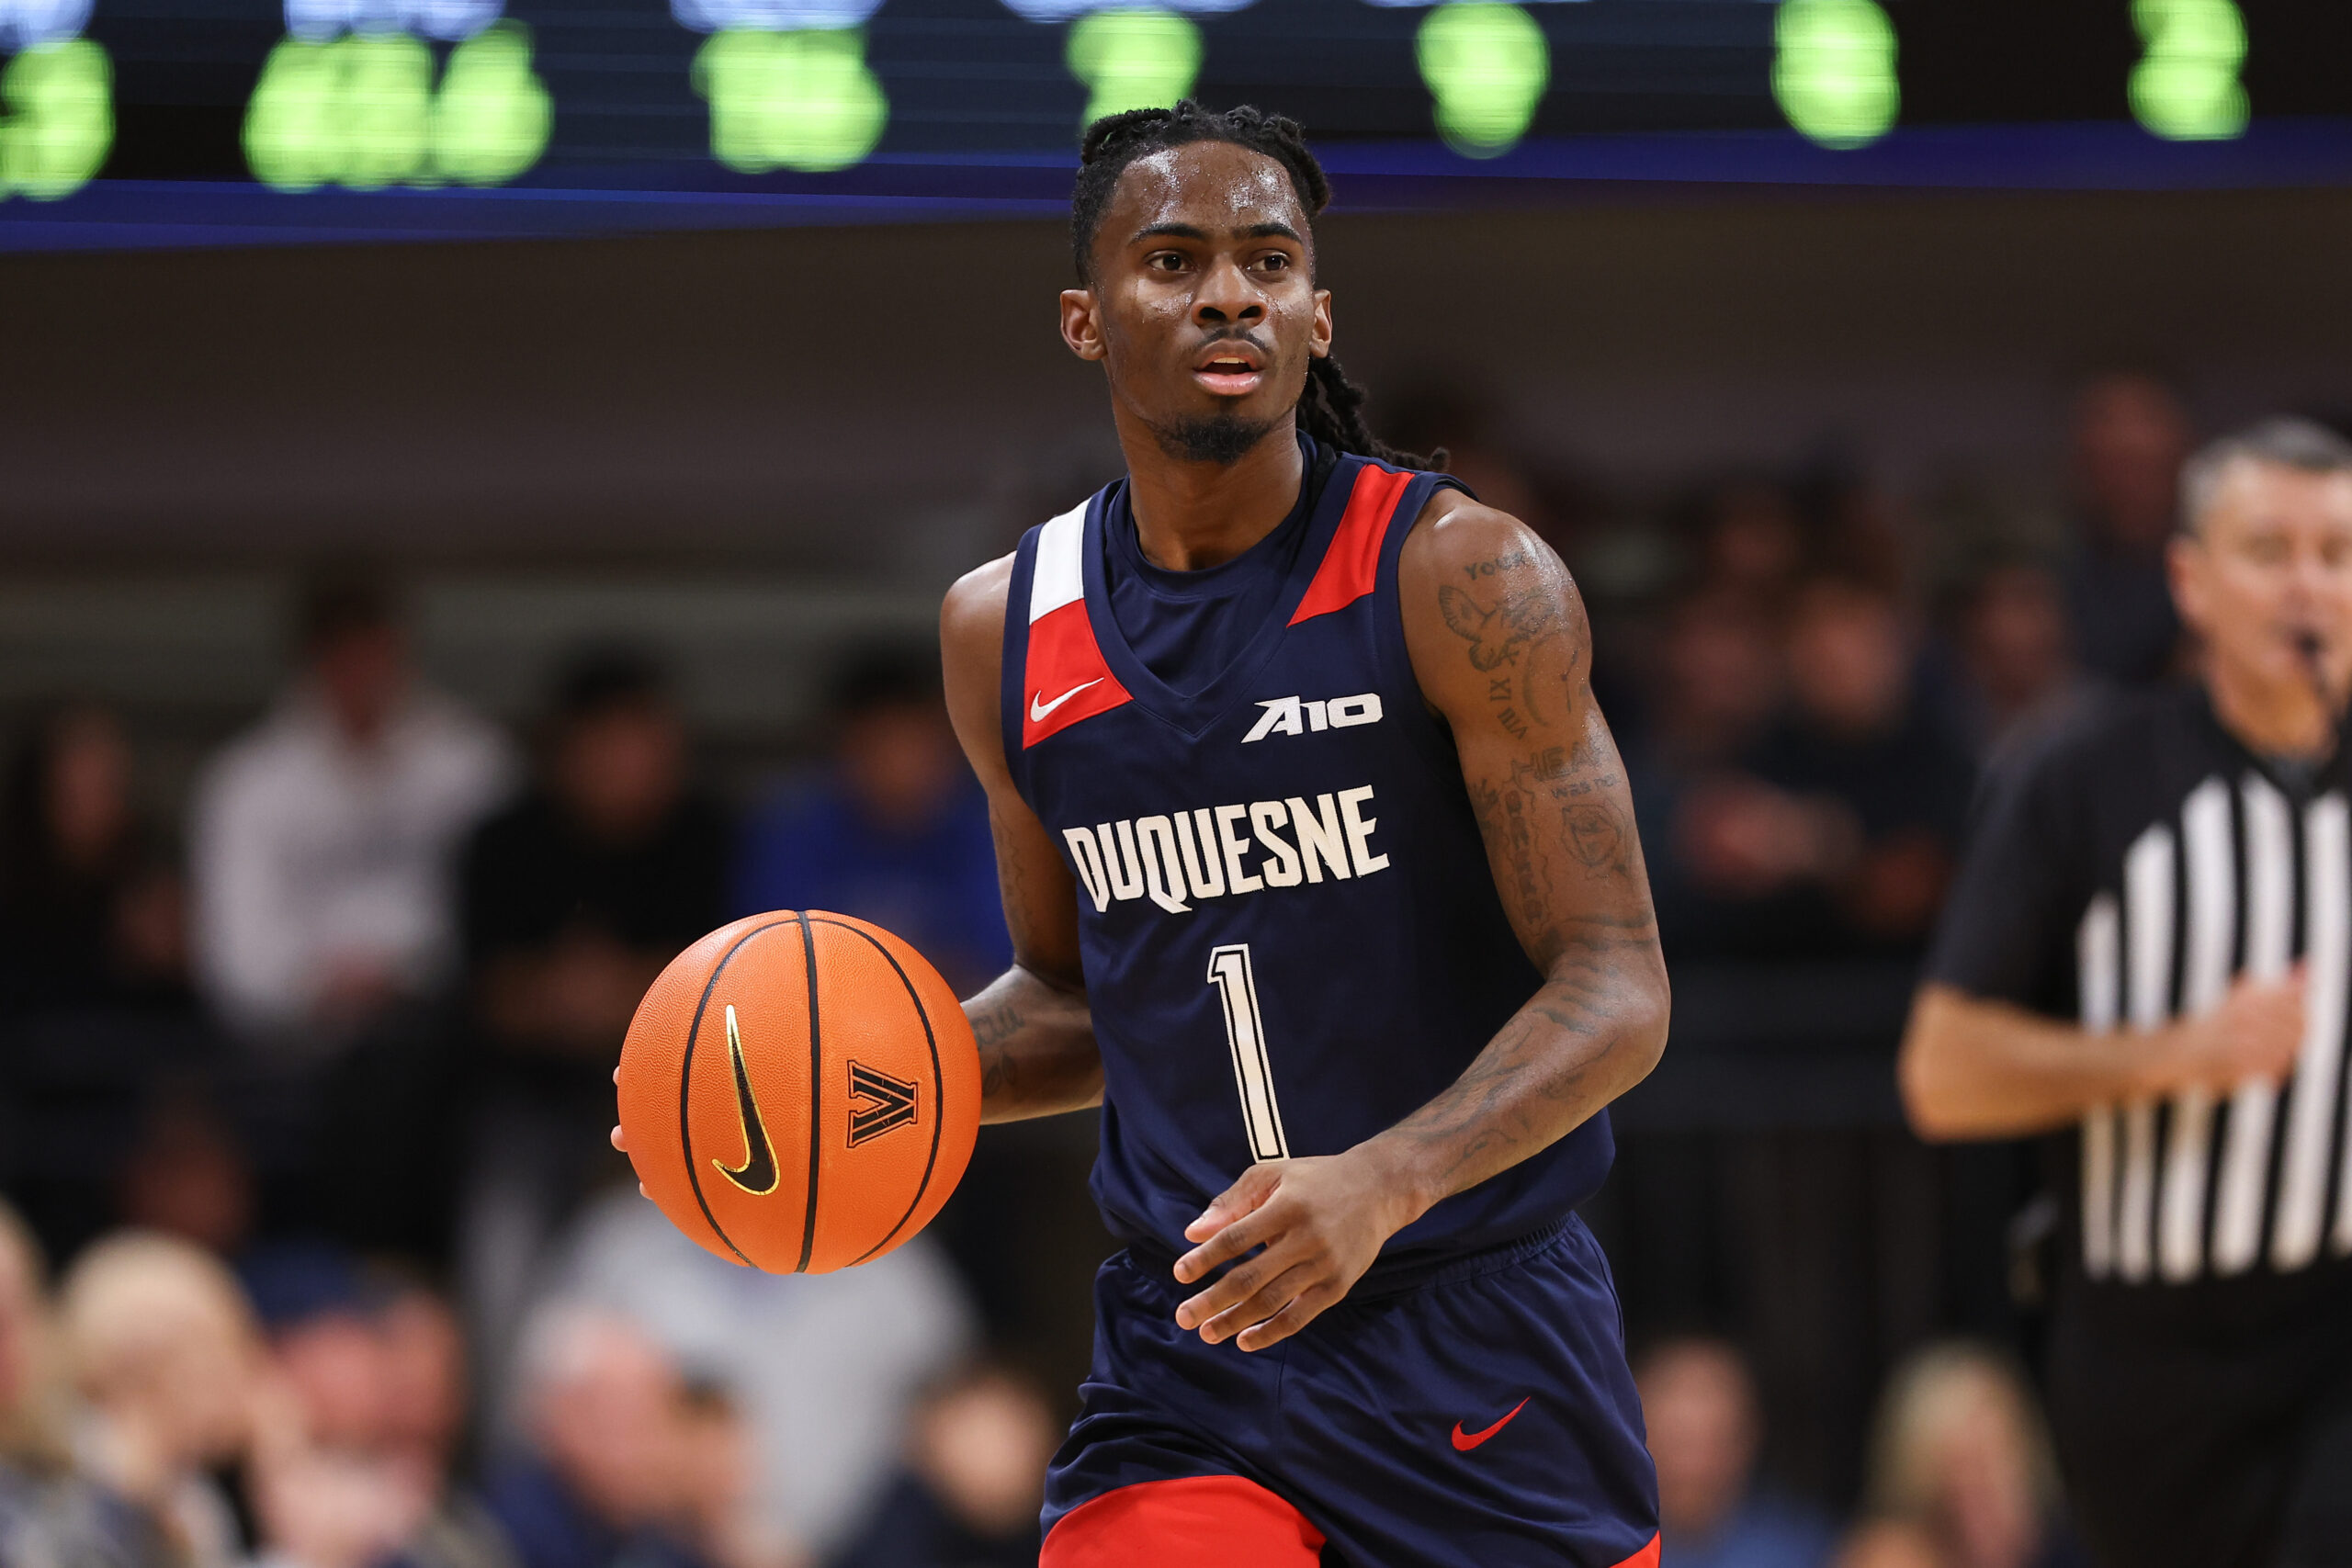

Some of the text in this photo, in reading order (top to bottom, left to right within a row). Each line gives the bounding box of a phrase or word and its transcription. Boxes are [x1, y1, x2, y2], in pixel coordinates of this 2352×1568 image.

[1240, 693, 1384, 744] A10
[1062, 784, 1391, 915] DUQUESNE
[846, 1059, 919, 1149] V
[1206, 942, 1291, 1164] 1
